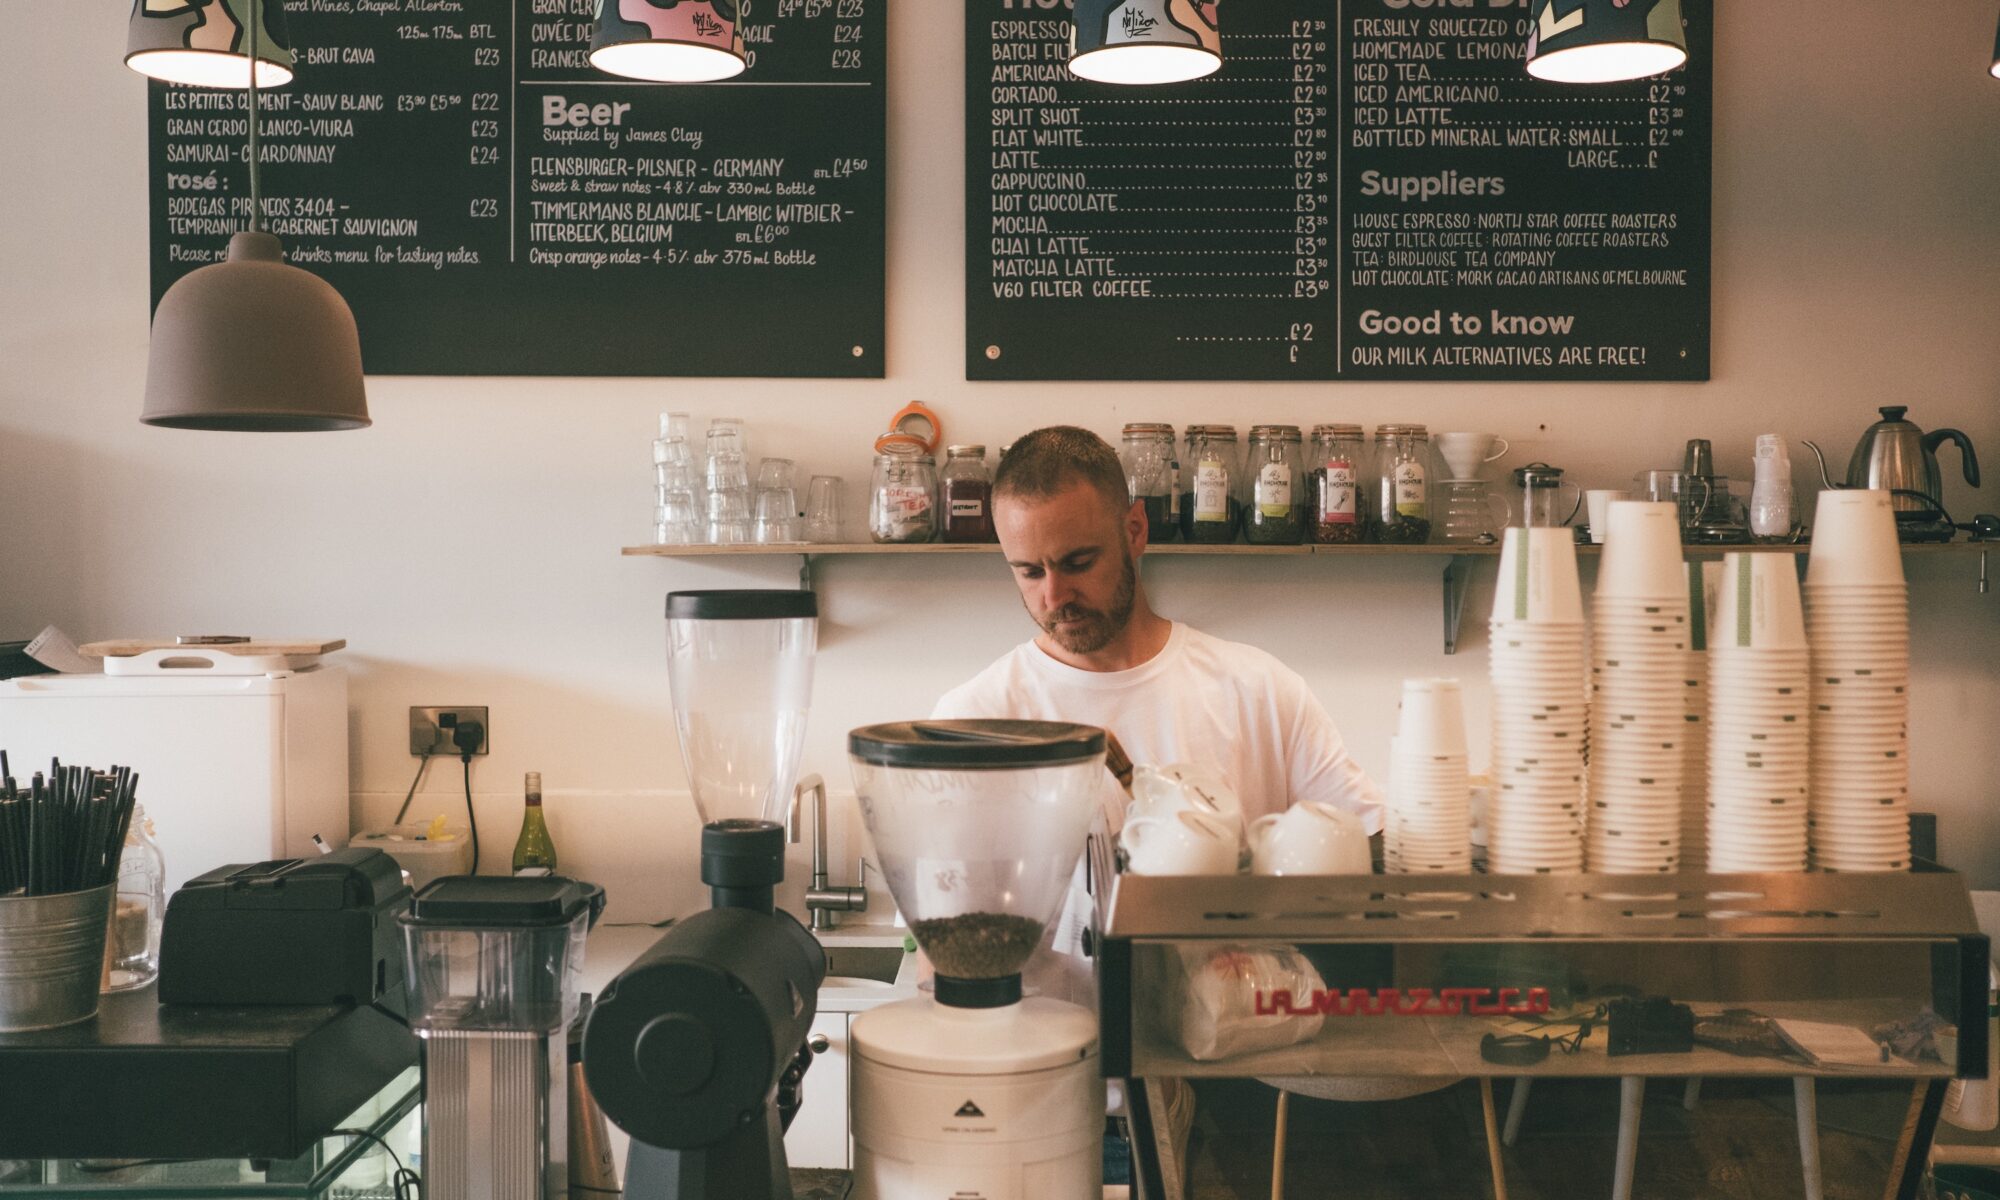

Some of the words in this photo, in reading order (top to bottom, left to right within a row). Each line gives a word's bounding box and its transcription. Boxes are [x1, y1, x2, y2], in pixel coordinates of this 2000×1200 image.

[357, 0, 400, 16] Chapel
[405, 0, 463, 11] Allerton
[532, 0, 566, 14] GRAN
[470, 24, 496, 38] BTL
[532, 19, 572, 42] CUVÉE
[834, 25, 862, 43] £24
[992, 21, 1069, 39] ESPRESSO
[1354, 19, 1419, 36] FRESHLY
[1429, 19, 1507, 37] SQUEEZED
[343, 48, 375, 64] CAVA
[475, 48, 499, 65] £23
[832, 49, 861, 68] £28
[992, 43, 1036, 60] BATCH
[1353, 42, 1445, 59] HOMEMADE
[1354, 64, 1388, 81] ICED
[1395, 64, 1431, 82] TEA
[166, 92, 186, 109] LES
[189, 92, 234, 109] PETITES
[341, 94, 383, 110] BLANC
[472, 93, 499, 110] £22
[992, 86, 1057, 104] CORTADO
[1355, 85, 1387, 103] ICED
[1395, 86, 1499, 103] AMERICANO
[543, 96, 630, 127] Beer
[992, 108, 1033, 126] SPLIT
[1040, 108, 1080, 126] SHOT
[1355, 107, 1388, 125] ICED
[1395, 108, 1452, 125] LATTE
[167, 119, 203, 135] GRAN
[208, 118, 248, 137] CERDO
[472, 120, 498, 138] £23
[543, 127, 599, 145] Supplied
[604, 127, 619, 149] by
[626, 128, 667, 142] James
[671, 127, 703, 149] Clay
[992, 130, 1027, 146] FLAT
[1033, 129, 1083, 147] WHITE
[1353, 129, 1425, 147] BOTTLED
[1432, 129, 1501, 146] MINERAL
[1569, 129, 1622, 146] SMALL
[167, 144, 229, 162] SAMURAI
[241, 144, 335, 163] CARDONNAY
[471, 146, 499, 164] £24
[992, 151, 1039, 169] LATTE
[1568, 150, 1618, 168] LARGE
[714, 158, 784, 177] GERMANY
[814, 169, 831, 178] BTL
[531, 179, 567, 192] Sweet
[571, 179, 581, 191] &
[585, 179, 618, 193] straw
[622, 180, 651, 194] notes
[699, 181, 722, 193] abv
[777, 182, 816, 195] Bottle
[991, 172, 1086, 190] CAPPUCCINO
[1361, 170, 1505, 201] Suppliers
[169, 197, 225, 216] BODEGAS
[231, 198, 290, 216] PIRNEOS
[294, 198, 335, 216] 3404
[471, 199, 497, 217] £23
[531, 201, 633, 221] TIMMERMANS
[637, 203, 702, 222] BLANCHE
[717, 203, 771, 222] LAMBIC
[776, 204, 841, 223] WITBIER
[992, 194, 1023, 212] HOT
[1029, 194, 1118, 212] CHOCOLATE
[272, 217, 339, 235] CABERNET
[343, 218, 417, 236] SAUVIGNON
[992, 216, 1048, 234] MOCHA
[1354, 213, 1399, 229] HOUSE
[1479, 213, 1522, 229] NORTH
[1527, 213, 1558, 228] STAR
[1564, 214, 1607, 228] COFFEE
[1612, 214, 1676, 228] ROASTERS
[611, 224, 672, 243] BELGIUM
[736, 233, 752, 242] BTL
[1352, 232, 1390, 247] GUEST
[1396, 232, 1436, 248] FILTER
[1493, 232, 1552, 247] ROTATING
[1556, 232, 1599, 247] COFFEE
[1603, 232, 1669, 247] ROASTERS
[170, 244, 211, 261] Please
[992, 238, 1029, 255] CHAI
[1038, 237, 1089, 255] LATTE
[292, 246, 332, 263] drinks
[334, 251, 369, 262] menu
[375, 245, 394, 263] for
[397, 246, 443, 270] tasting
[530, 248, 562, 267] Crisp
[565, 252, 608, 269] orange
[694, 249, 718, 264] abv
[774, 250, 816, 265] Bottle
[1389, 251, 1457, 266] BIRDHOUSE
[1465, 251, 1487, 266] TEA
[1494, 251, 1555, 266] COMPANY
[993, 259, 1058, 277] MATCHA
[1065, 258, 1116, 276] LATTE
[1352, 270, 1378, 286] HOT
[1457, 270, 1492, 285] MORK
[1497, 271, 1536, 286] CACAO
[1539, 271, 1599, 285] ARTISANS
[993, 282, 1023, 298] V60
[1031, 281, 1083, 297] FILTER
[1093, 280, 1152, 297] COFFEE
[1360, 310, 1440, 334] Good
[1450, 312, 1481, 335] to
[1492, 310, 1574, 335] know
[1352, 347, 1383, 365] OUR
[1388, 347, 1427, 365] MILK
[1433, 347, 1552, 365] ALTERNATIVES
[1559, 347, 1592, 365] ARE
[1598, 346, 1646, 365] FREE!
